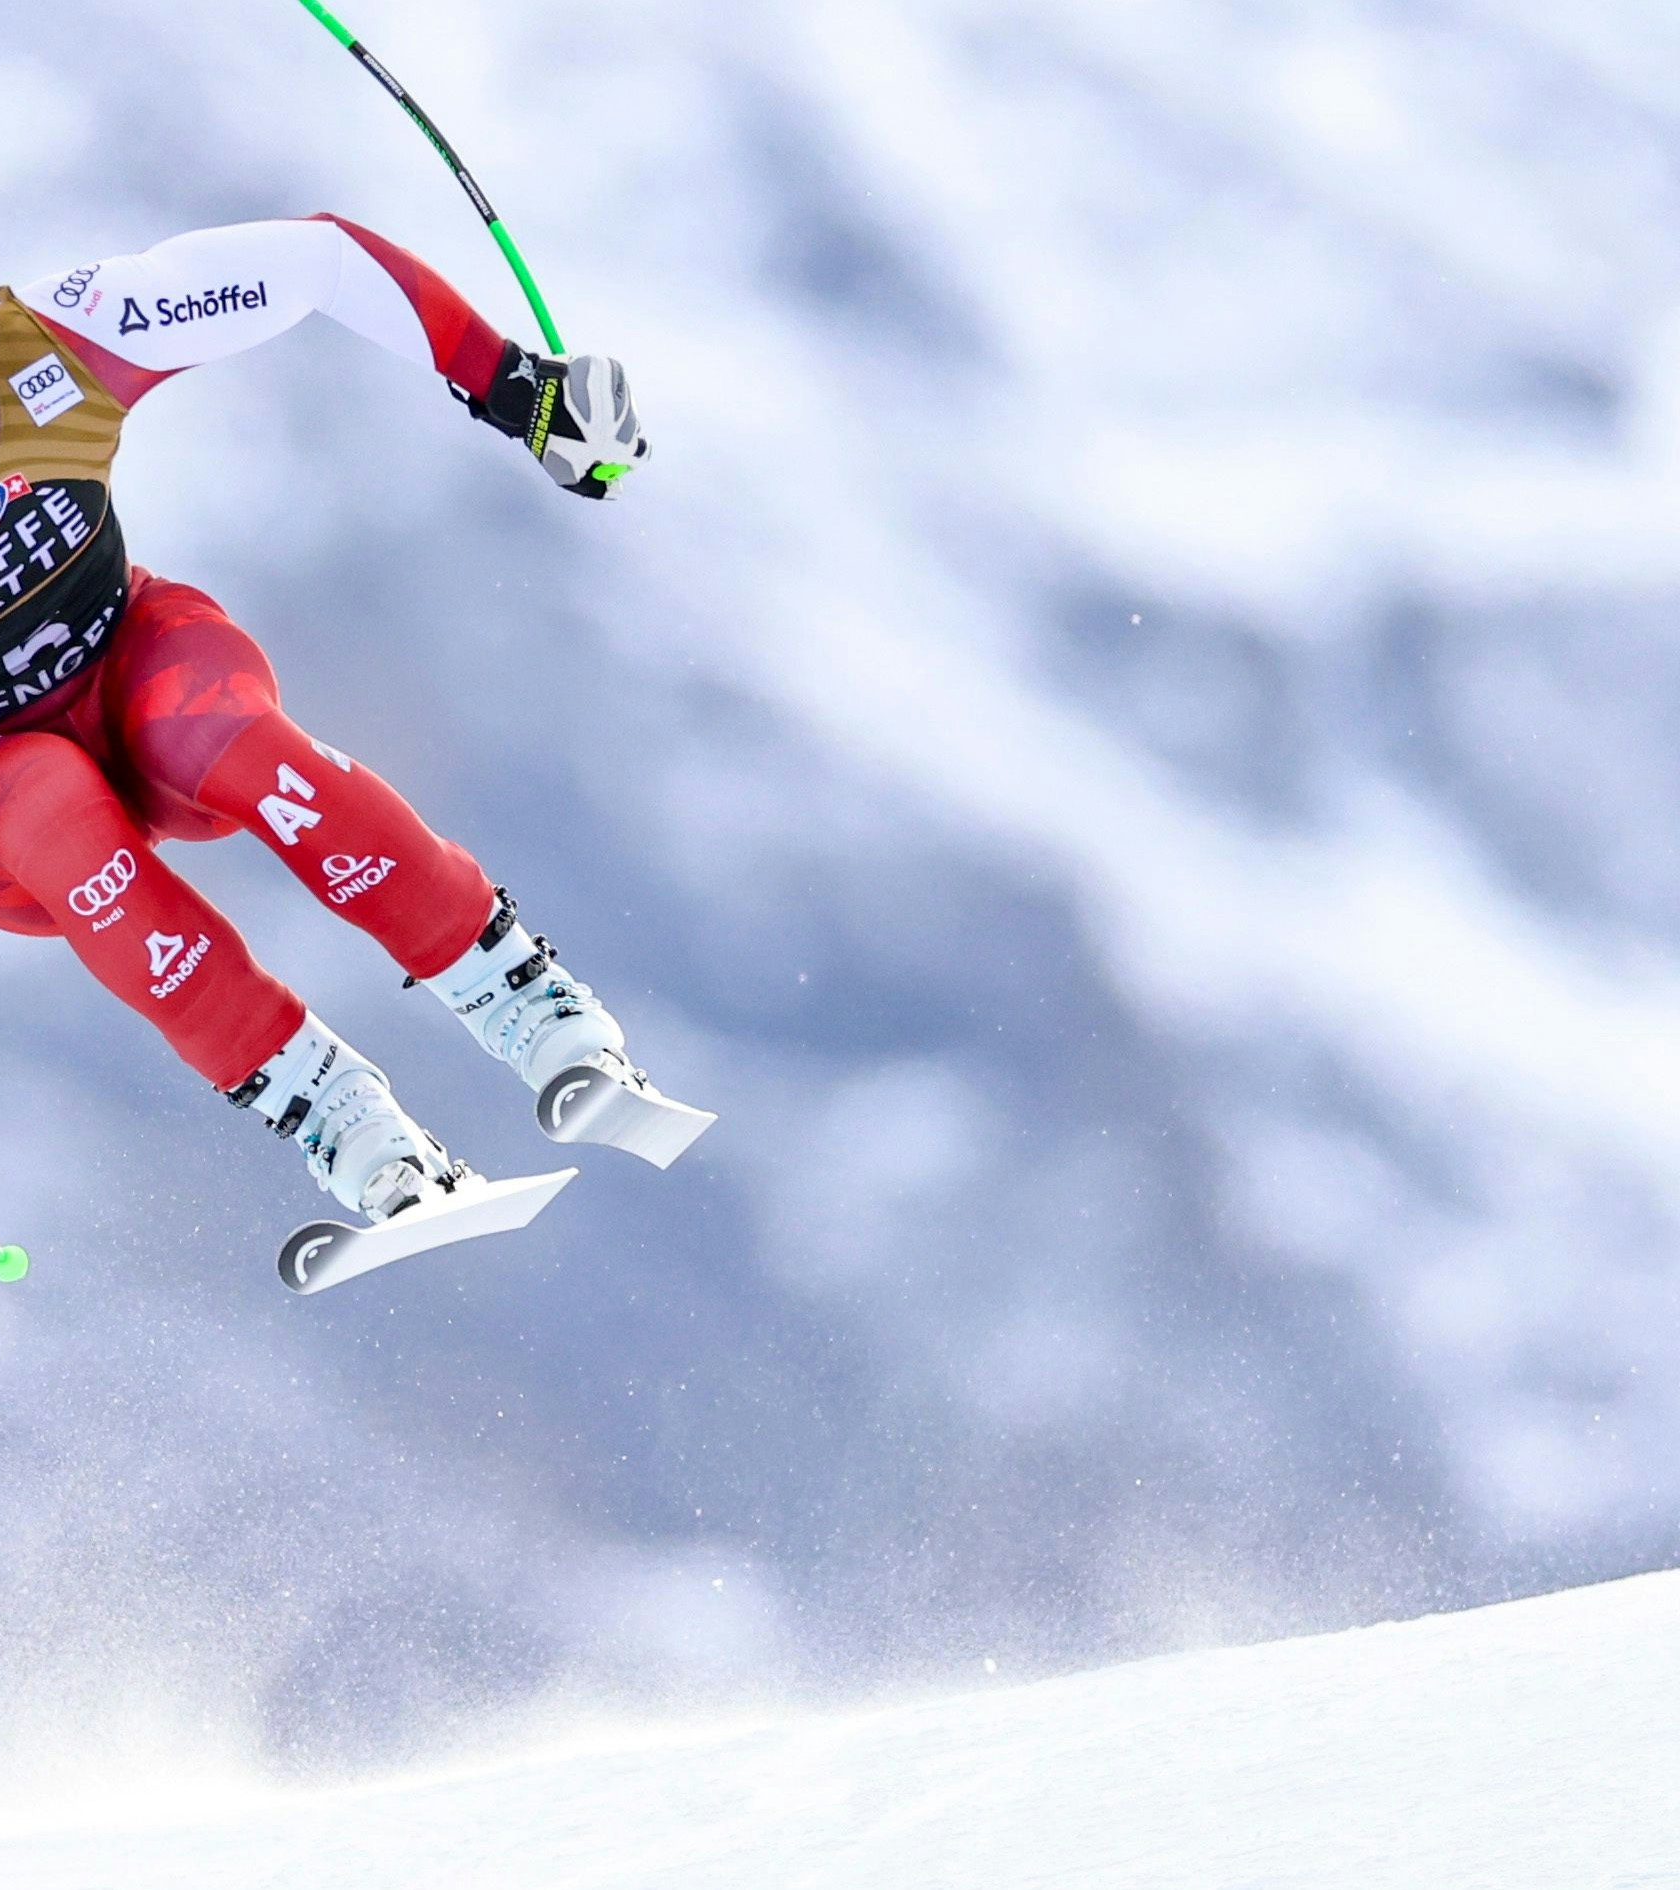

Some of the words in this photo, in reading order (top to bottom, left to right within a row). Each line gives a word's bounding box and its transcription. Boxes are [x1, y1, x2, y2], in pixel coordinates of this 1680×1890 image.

[83, 289, 104, 317] Audi
[158, 281, 268, 327] Schöffel
[530, 378, 559, 457] KOMPERDE
[257, 762, 323, 846] A1
[327, 856, 398, 905] UNIQA
[91, 905, 126, 934] Audi
[149, 933, 213, 1000] Schöffel
[453, 992, 495, 1015] EAD
[310, 1042, 338, 1087] HEA
